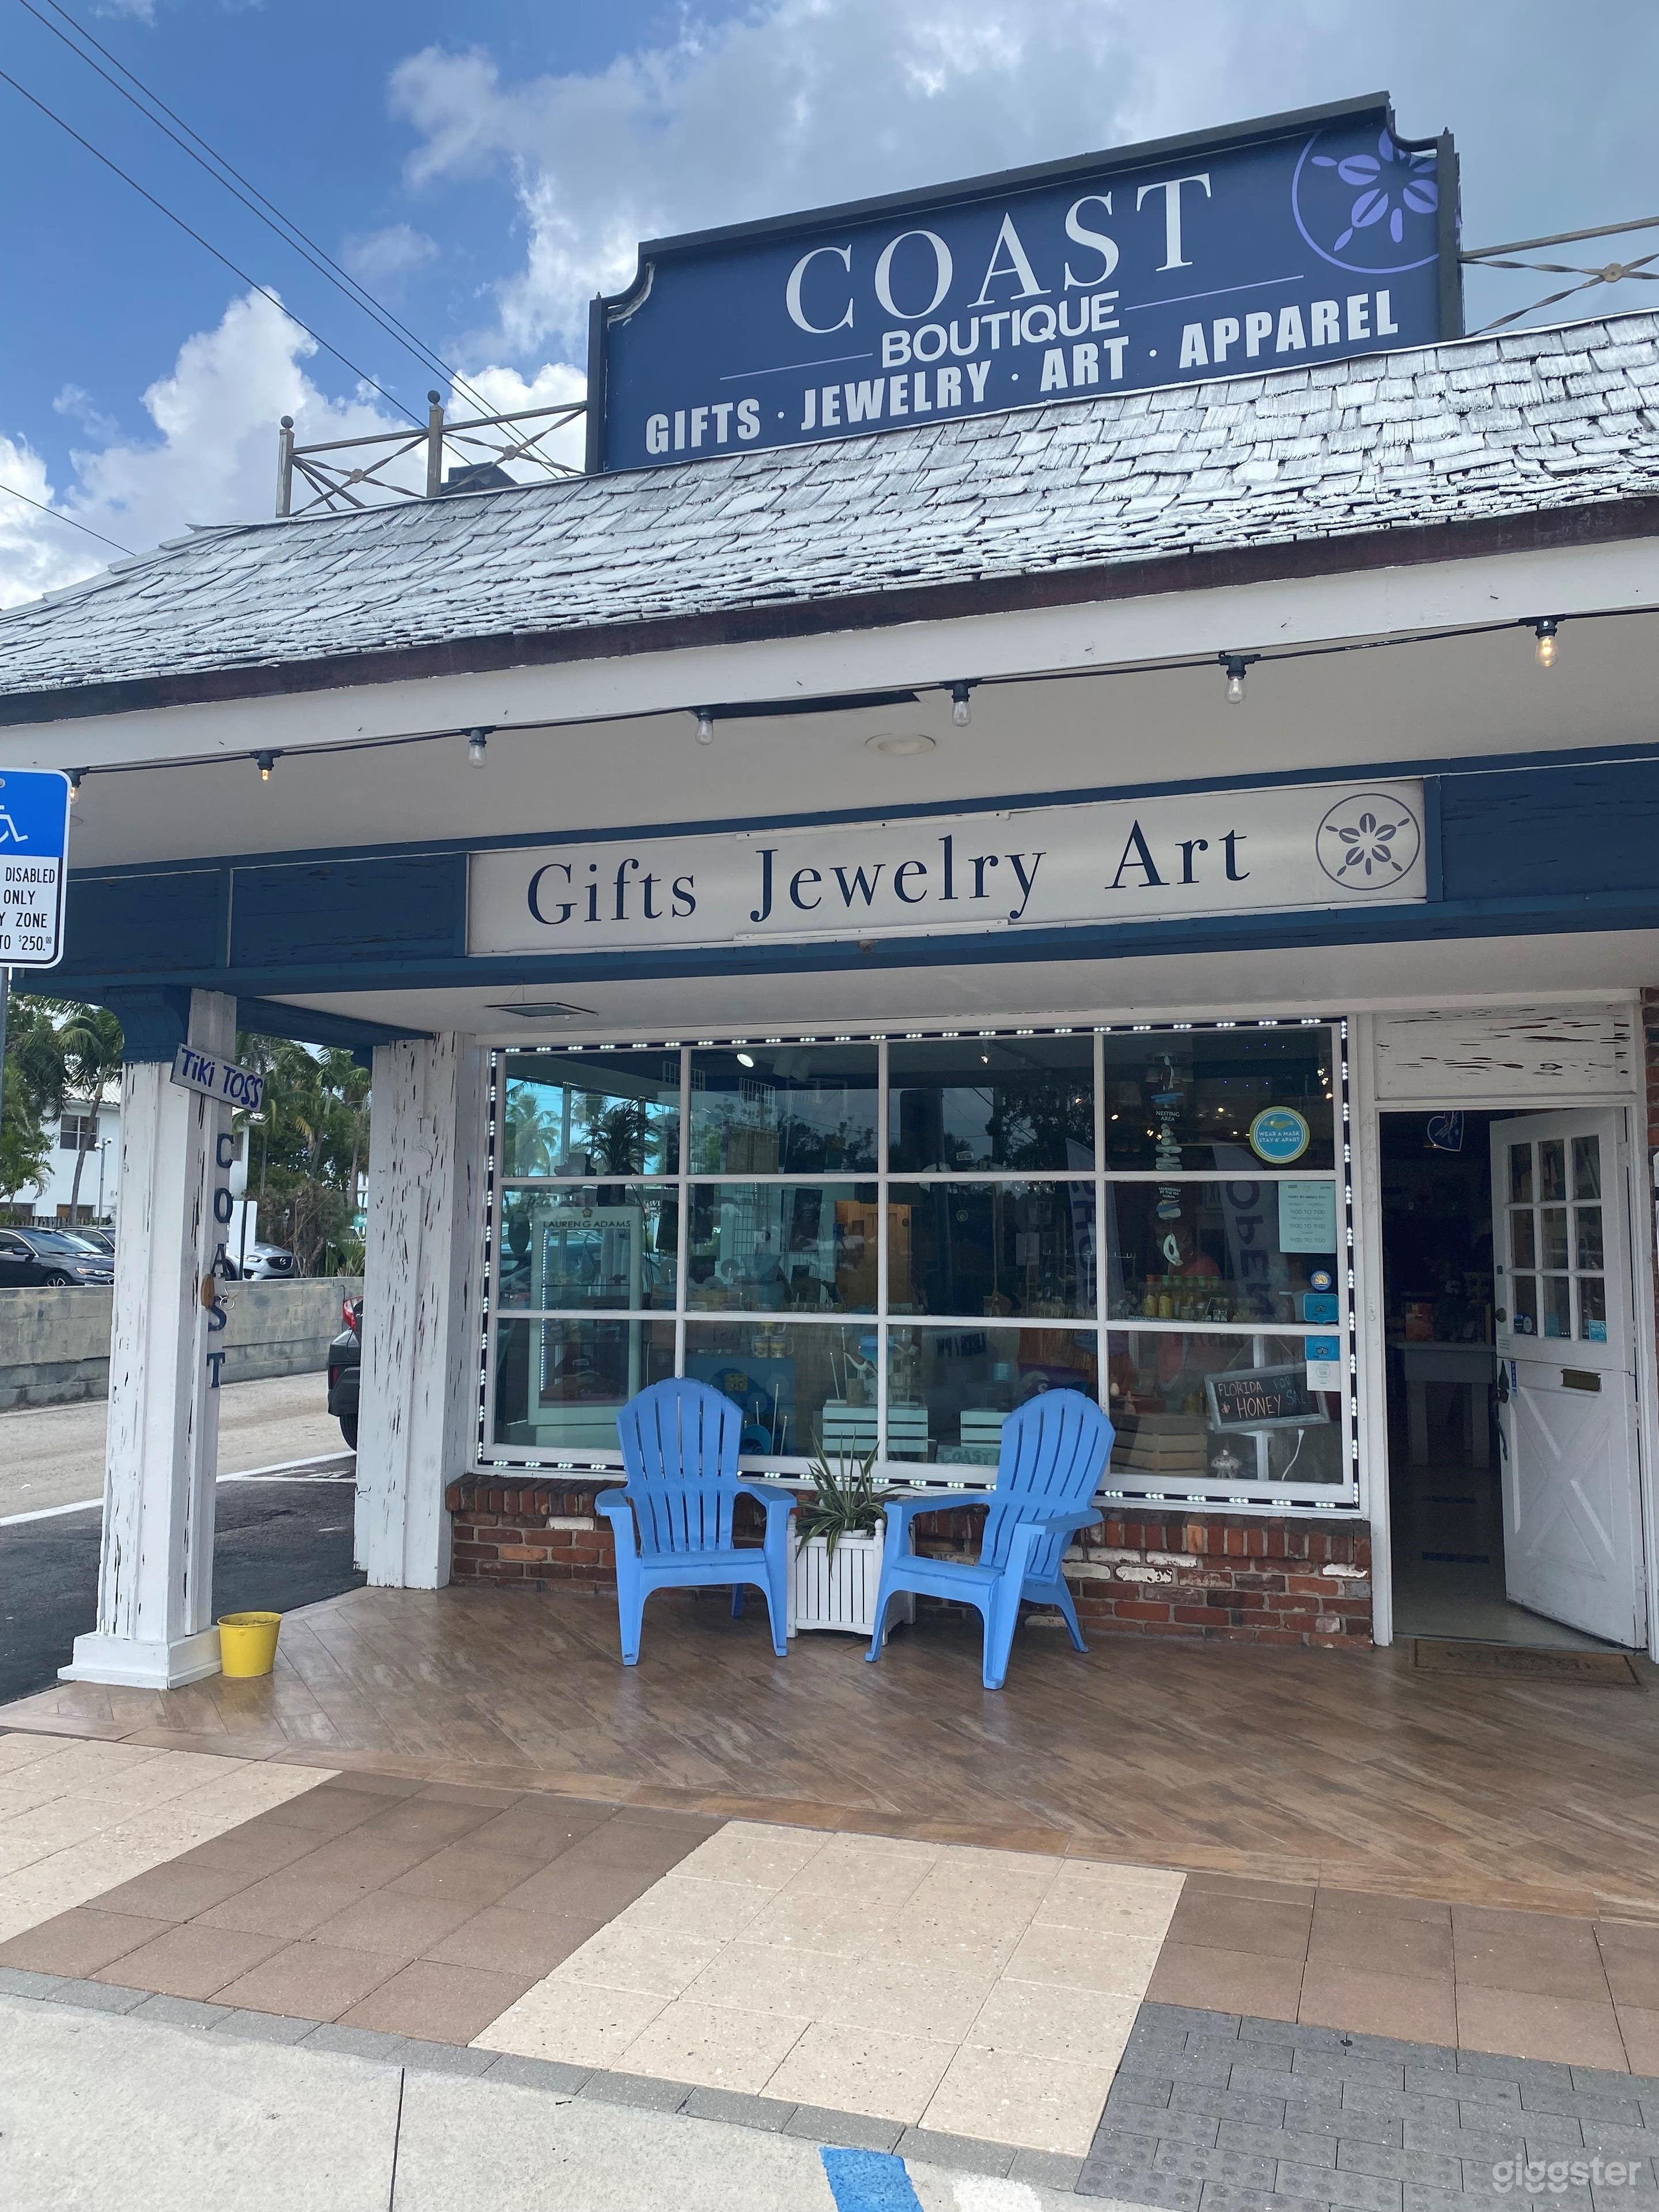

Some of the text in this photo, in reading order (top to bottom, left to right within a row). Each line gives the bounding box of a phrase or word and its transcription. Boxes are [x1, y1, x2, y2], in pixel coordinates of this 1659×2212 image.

[785, 173, 1213, 335] COAST
[882, 290, 1120, 369] BOUTIQUE
[645, 289, 1399, 455] GIFTS JEWELRY ART APPAREL
[5, 867, 55, 883] DISABLED
[527, 819, 1251, 926] Gifts Jewelry Art
[3, 889, 36, 905] ONLY
[16, 912, 47, 928] ZONE
[224, 1066, 263, 1108] TOSS
[1218, 1381, 1263, 1396] FLORIDA
[1236, 1394, 1281, 1419] HONEY
